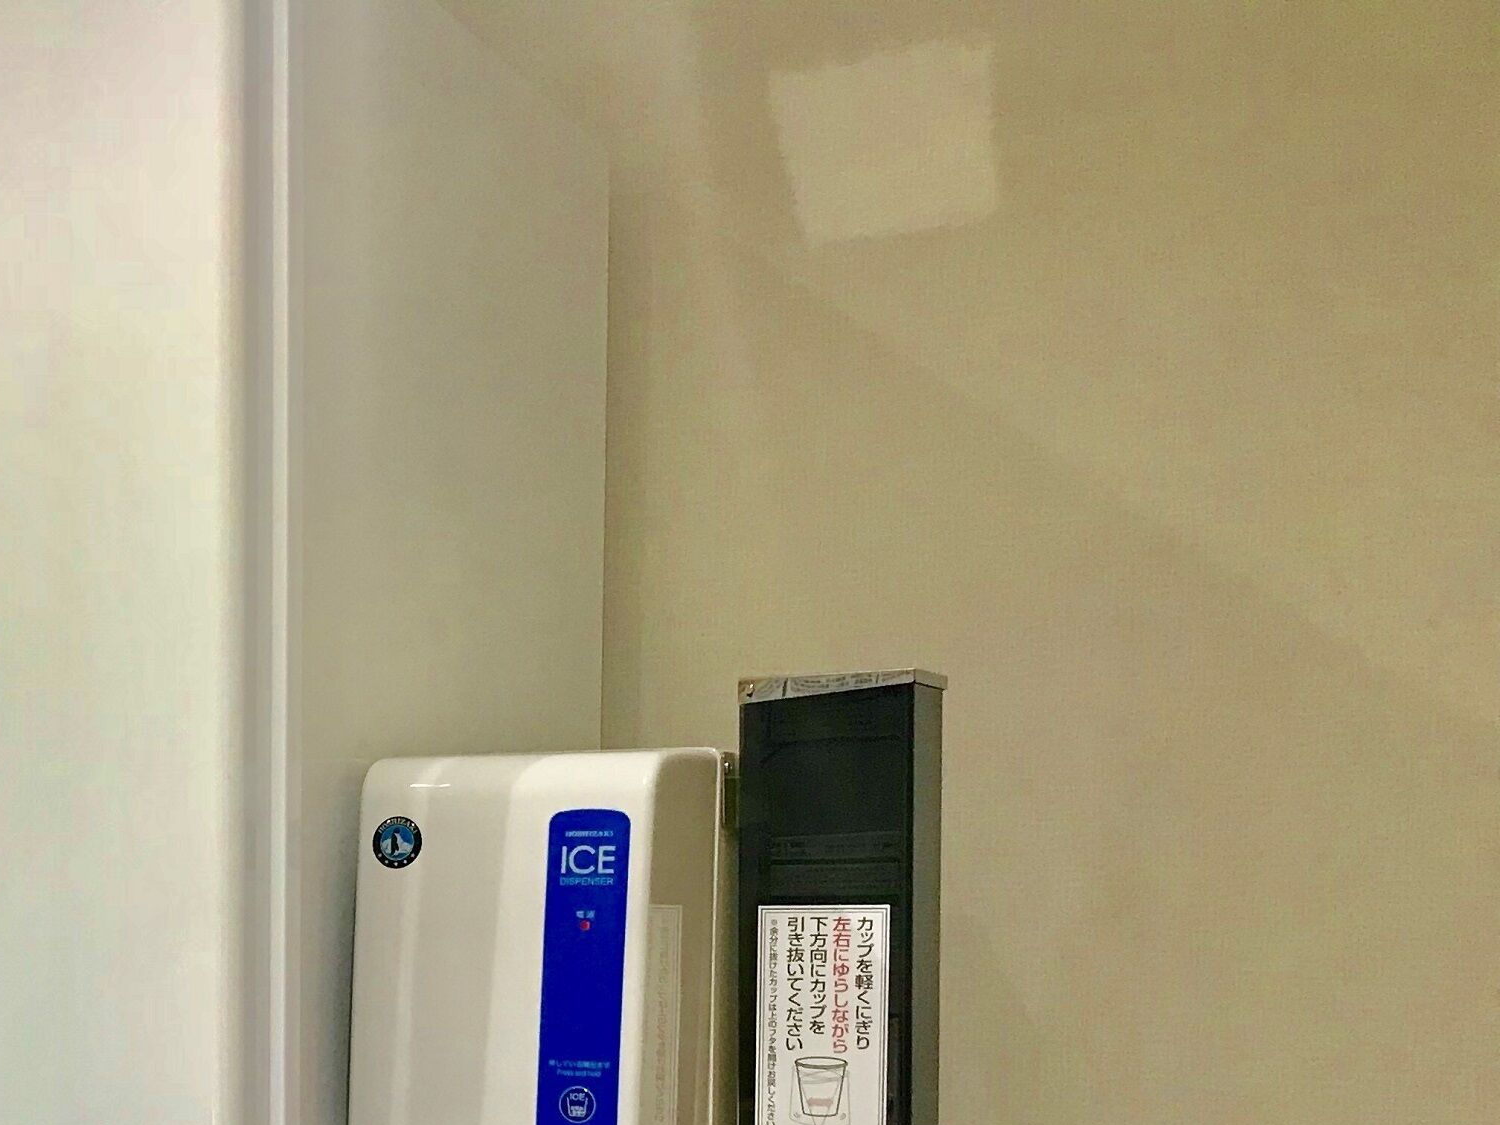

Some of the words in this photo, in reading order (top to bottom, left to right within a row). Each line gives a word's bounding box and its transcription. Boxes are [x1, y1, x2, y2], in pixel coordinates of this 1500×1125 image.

[559, 876, 614, 887] DISPENSER
[560, 845, 617, 875] ICE
[785, 916, 805, 1051] 引き抜いてください
[809, 916, 829, 1035] 下方向にカップを
[831, 916, 852, 1054] 左右にゆらしながら
[854, 916, 875, 1050] カップを軽くにぎり
